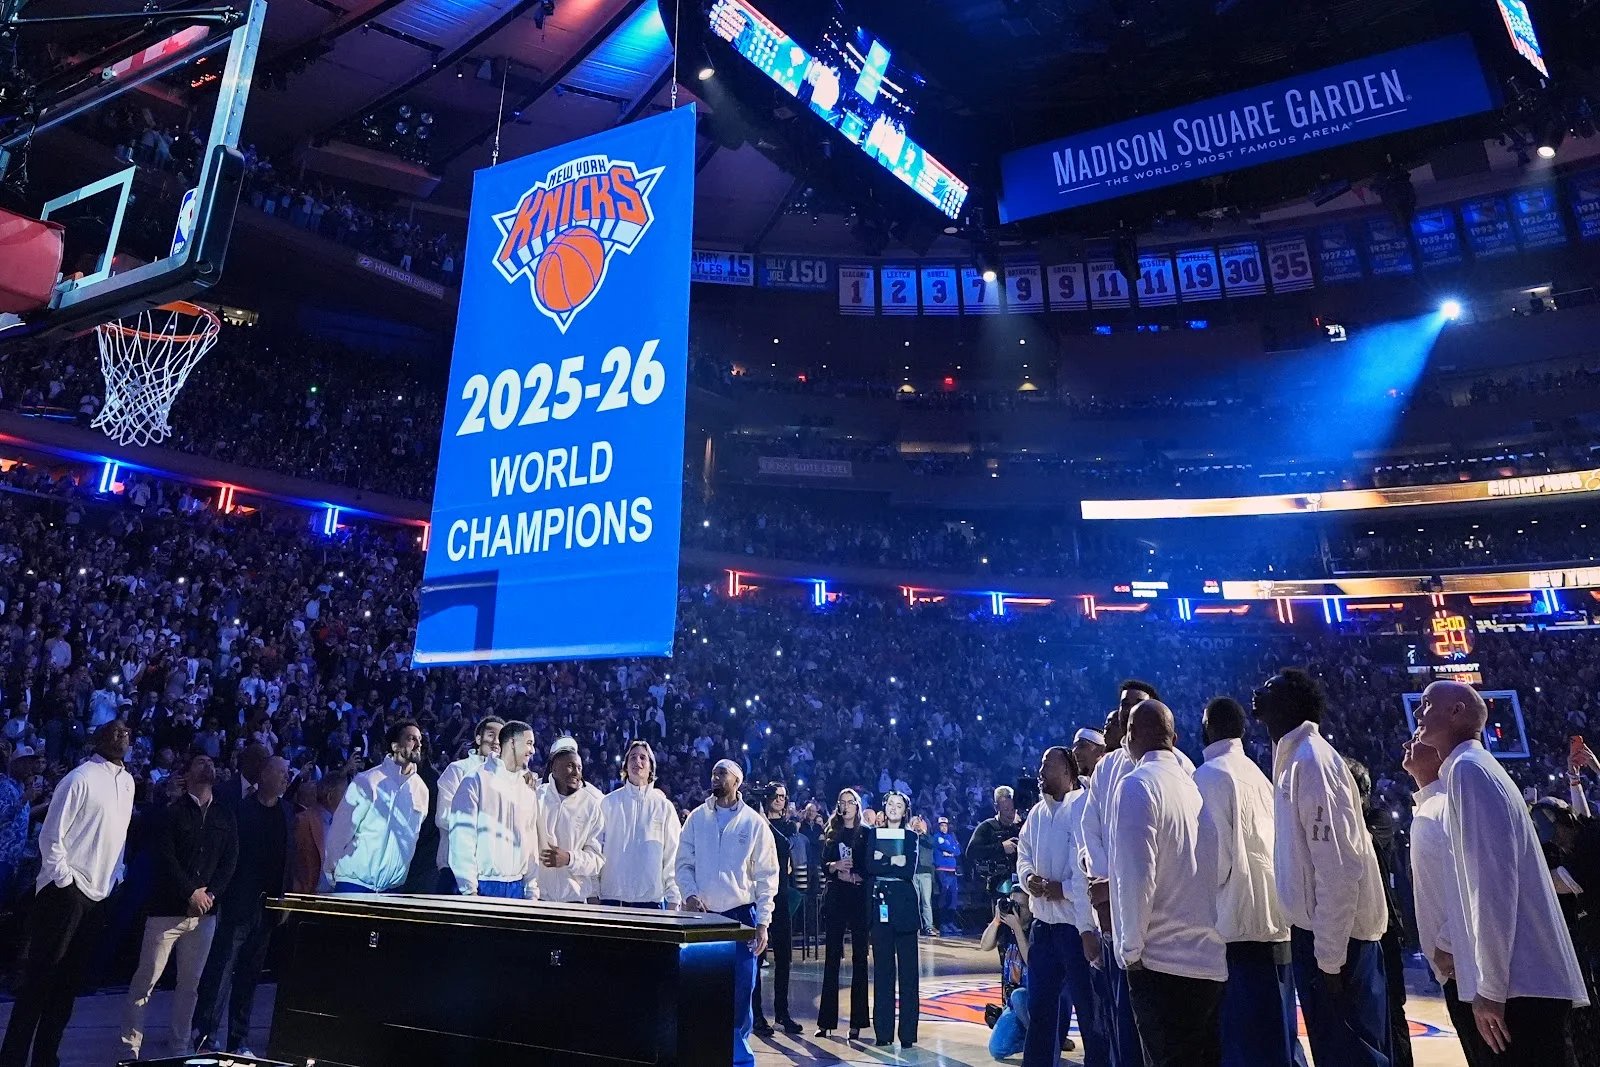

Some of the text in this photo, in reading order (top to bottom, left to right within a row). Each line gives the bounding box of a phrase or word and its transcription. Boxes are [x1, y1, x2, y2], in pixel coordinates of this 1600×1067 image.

[1052, 69, 1405, 186] MADISON SQUARE GARDEN
[1105, 122, 1350, 187] THE WORLD'S MOST FAMOUS ARENA
[548, 158, 606, 189] NEW YORK
[500, 166, 649, 263] KNICKS
[692, 252, 719, 263] ARRY
[694, 262, 723, 275] YLES
[727, 255, 750, 278] 15
[1271, 252, 1308, 280] 35
[374, 262, 413, 284] HYUNDAI
[767, 270, 785, 281] JOEL
[789, 259, 827, 283] 150
[1143, 269, 1168, 295] 11
[1183, 263, 1213, 290] 19
[1225, 257, 1260, 285] 30
[851, 280, 862, 304] 1
[891, 279, 907, 304] 2
[932, 279, 947, 304] 3
[972, 278, 986, 303] 7
[1016, 277, 1032, 301] 9
[1059, 275, 1075, 299] 9
[1097, 273, 1121, 297] 11
[456, 339, 665, 436] 2025-26
[490, 441, 613, 497] WORLD
[1488, 474, 1582, 496] CHAMPIONS
[447, 496, 652, 562] CHAMPIONS
[1432, 616, 1466, 632] 12:00
[1433, 631, 1469, 656] 24
[1445, 663, 1480, 673] TISSOT
